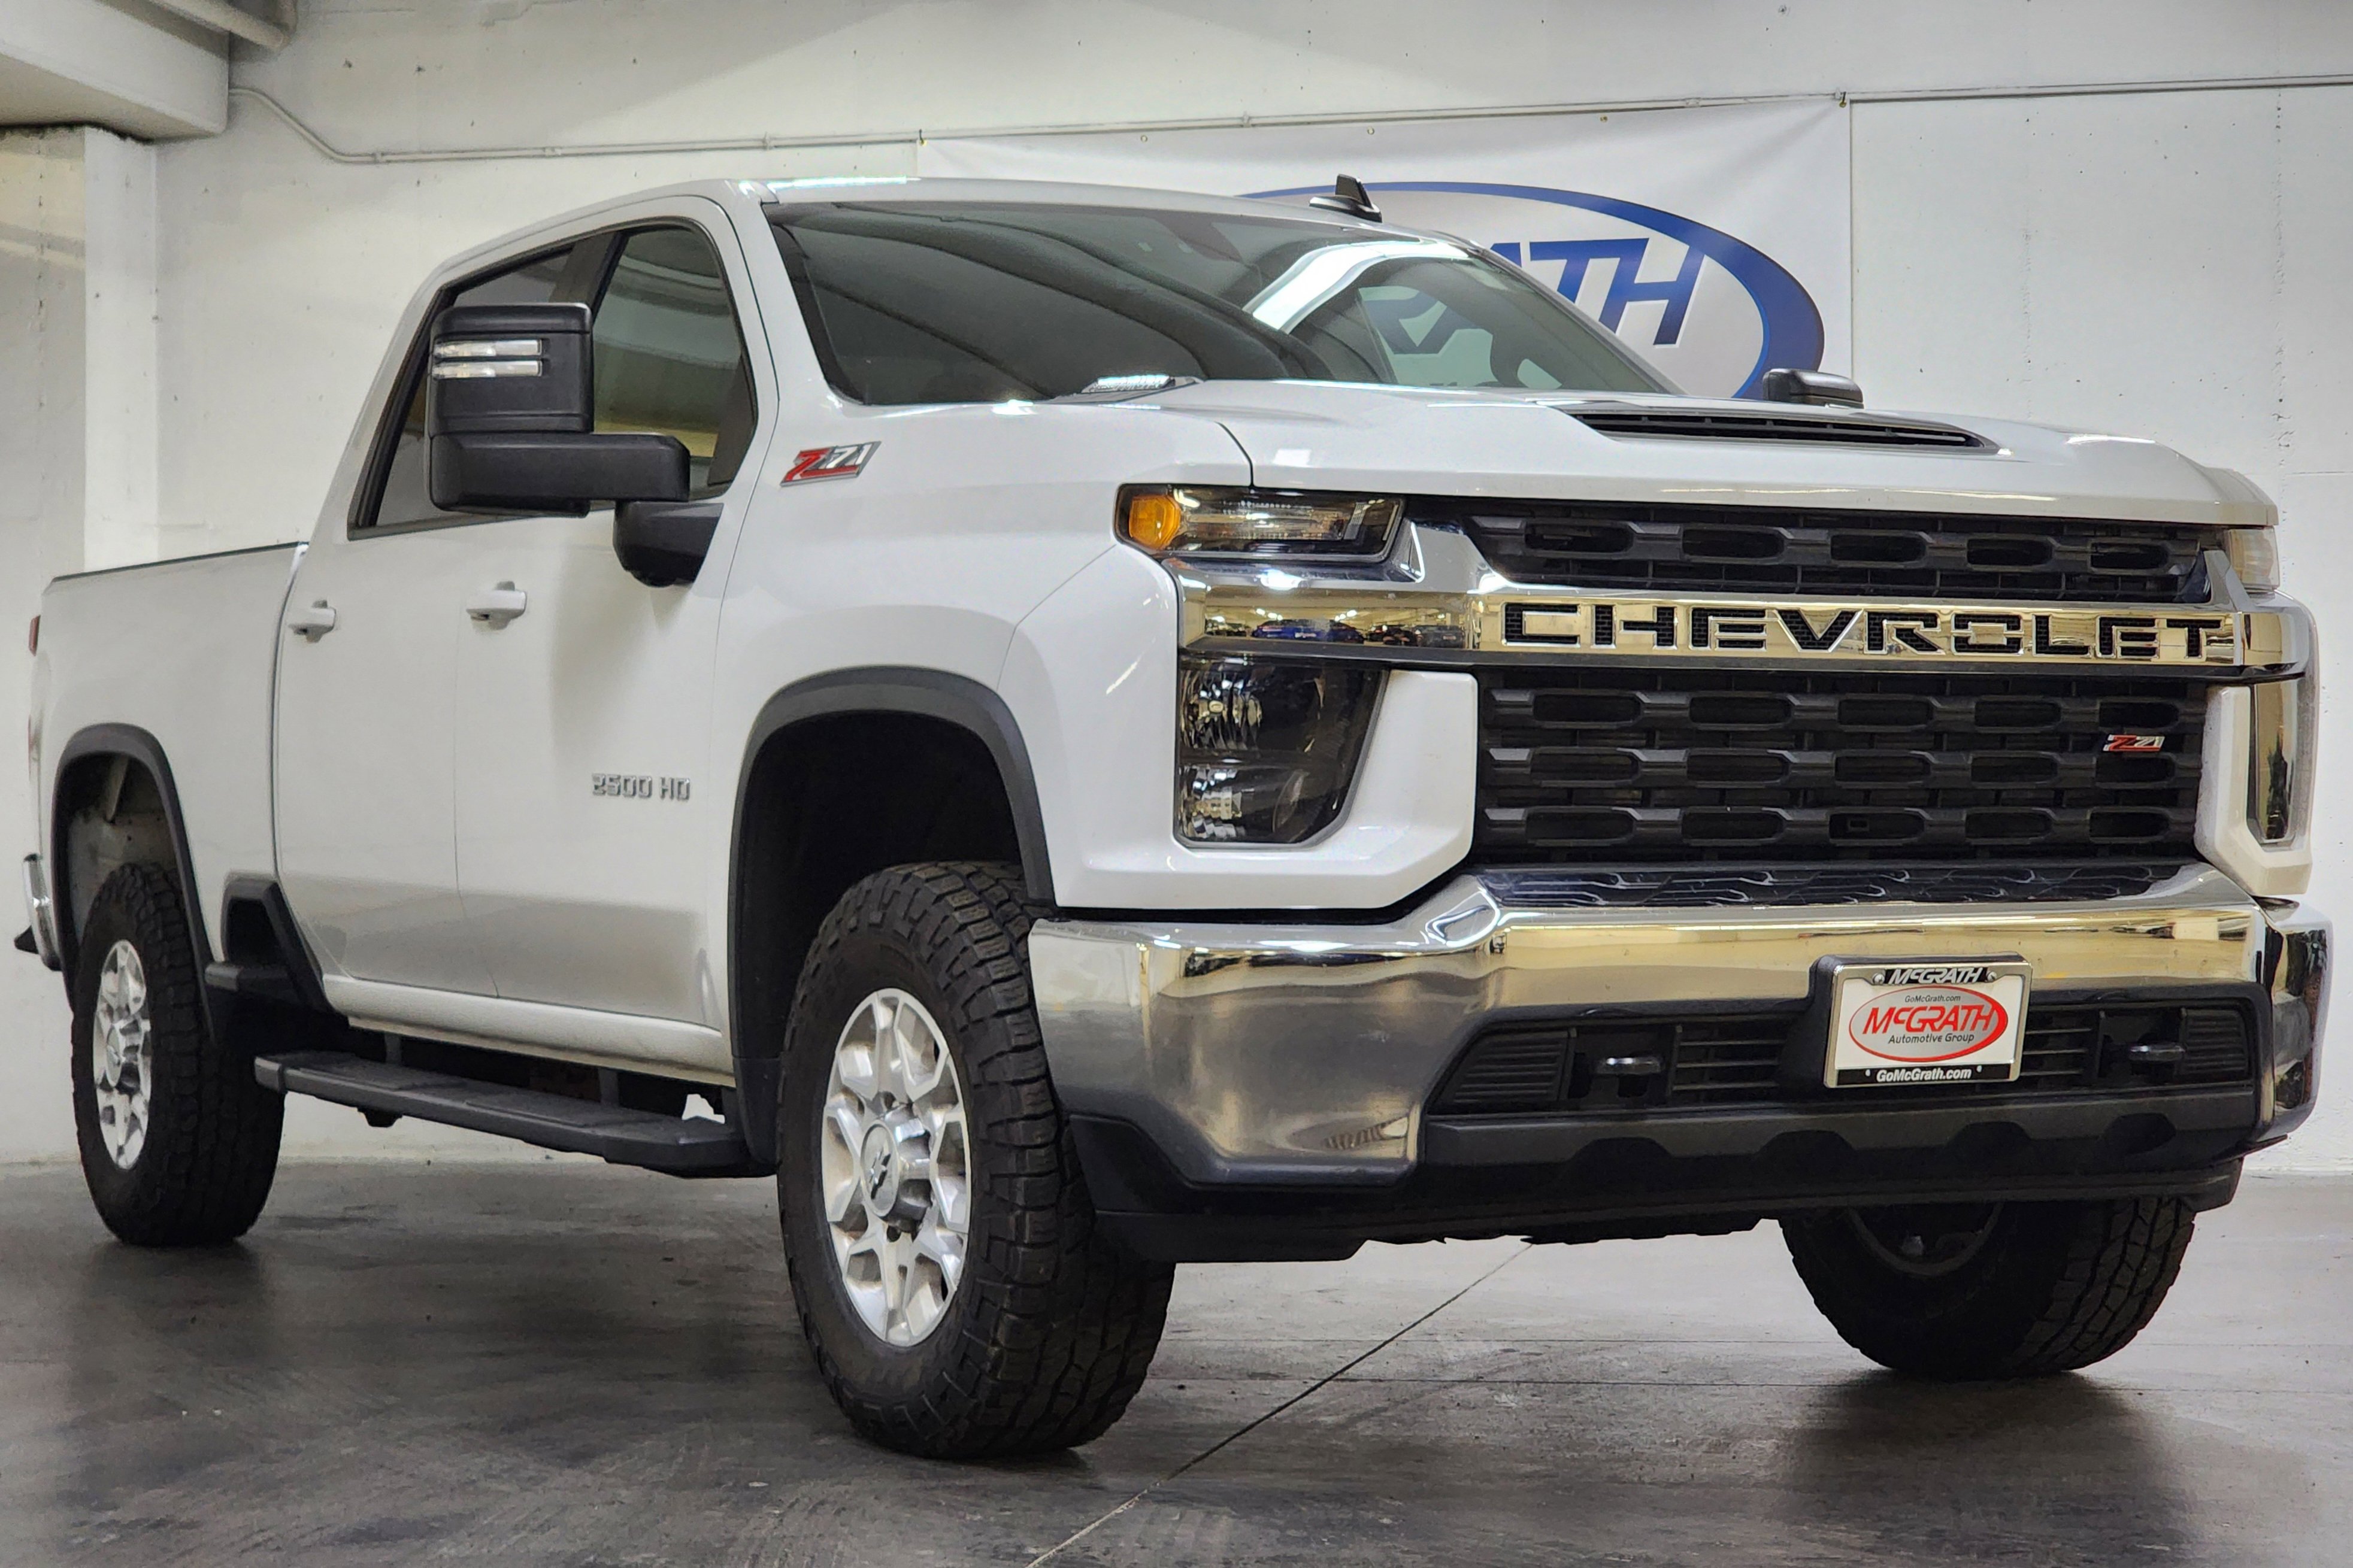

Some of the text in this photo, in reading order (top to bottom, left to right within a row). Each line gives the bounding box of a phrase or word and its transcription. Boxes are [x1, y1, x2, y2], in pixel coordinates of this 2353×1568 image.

[780, 441, 881, 487] Z71
[1501, 600, 2222, 660] CHEVROLET
[2103, 735, 2165, 751] Z71
[592, 773, 691, 801] 2500 HD
[1904, 994, 1961, 1003] GoMcGrath.com
[1888, 1033, 1975, 1044] Automotive Group
[1876, 1067, 1972, 1082] GoMcGrath.com
